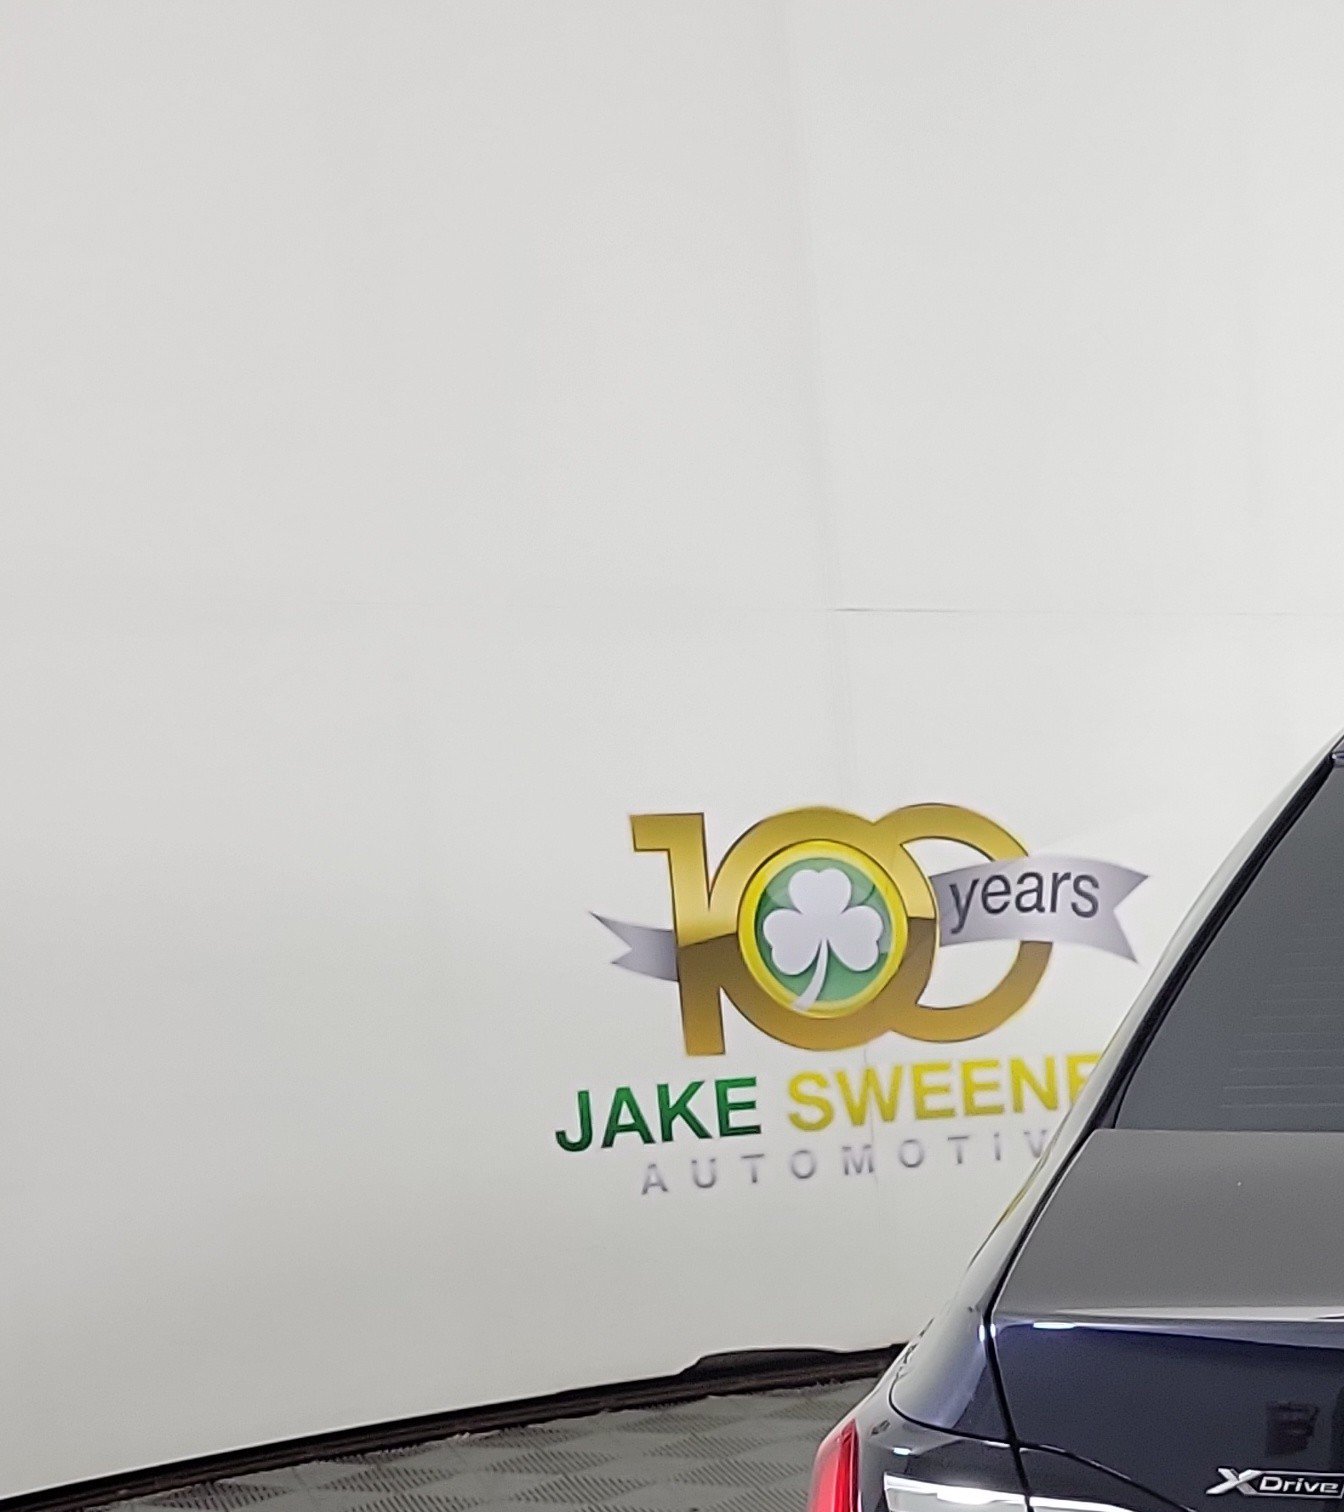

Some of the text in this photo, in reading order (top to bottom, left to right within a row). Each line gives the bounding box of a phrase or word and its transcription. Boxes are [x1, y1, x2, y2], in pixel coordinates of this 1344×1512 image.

[629, 803, 1101, 1056] 100 years
[555, 1052, 1101, 1153] JAKE SWEENE
[640, 1128, 1048, 1196] AUTOMOTIV
